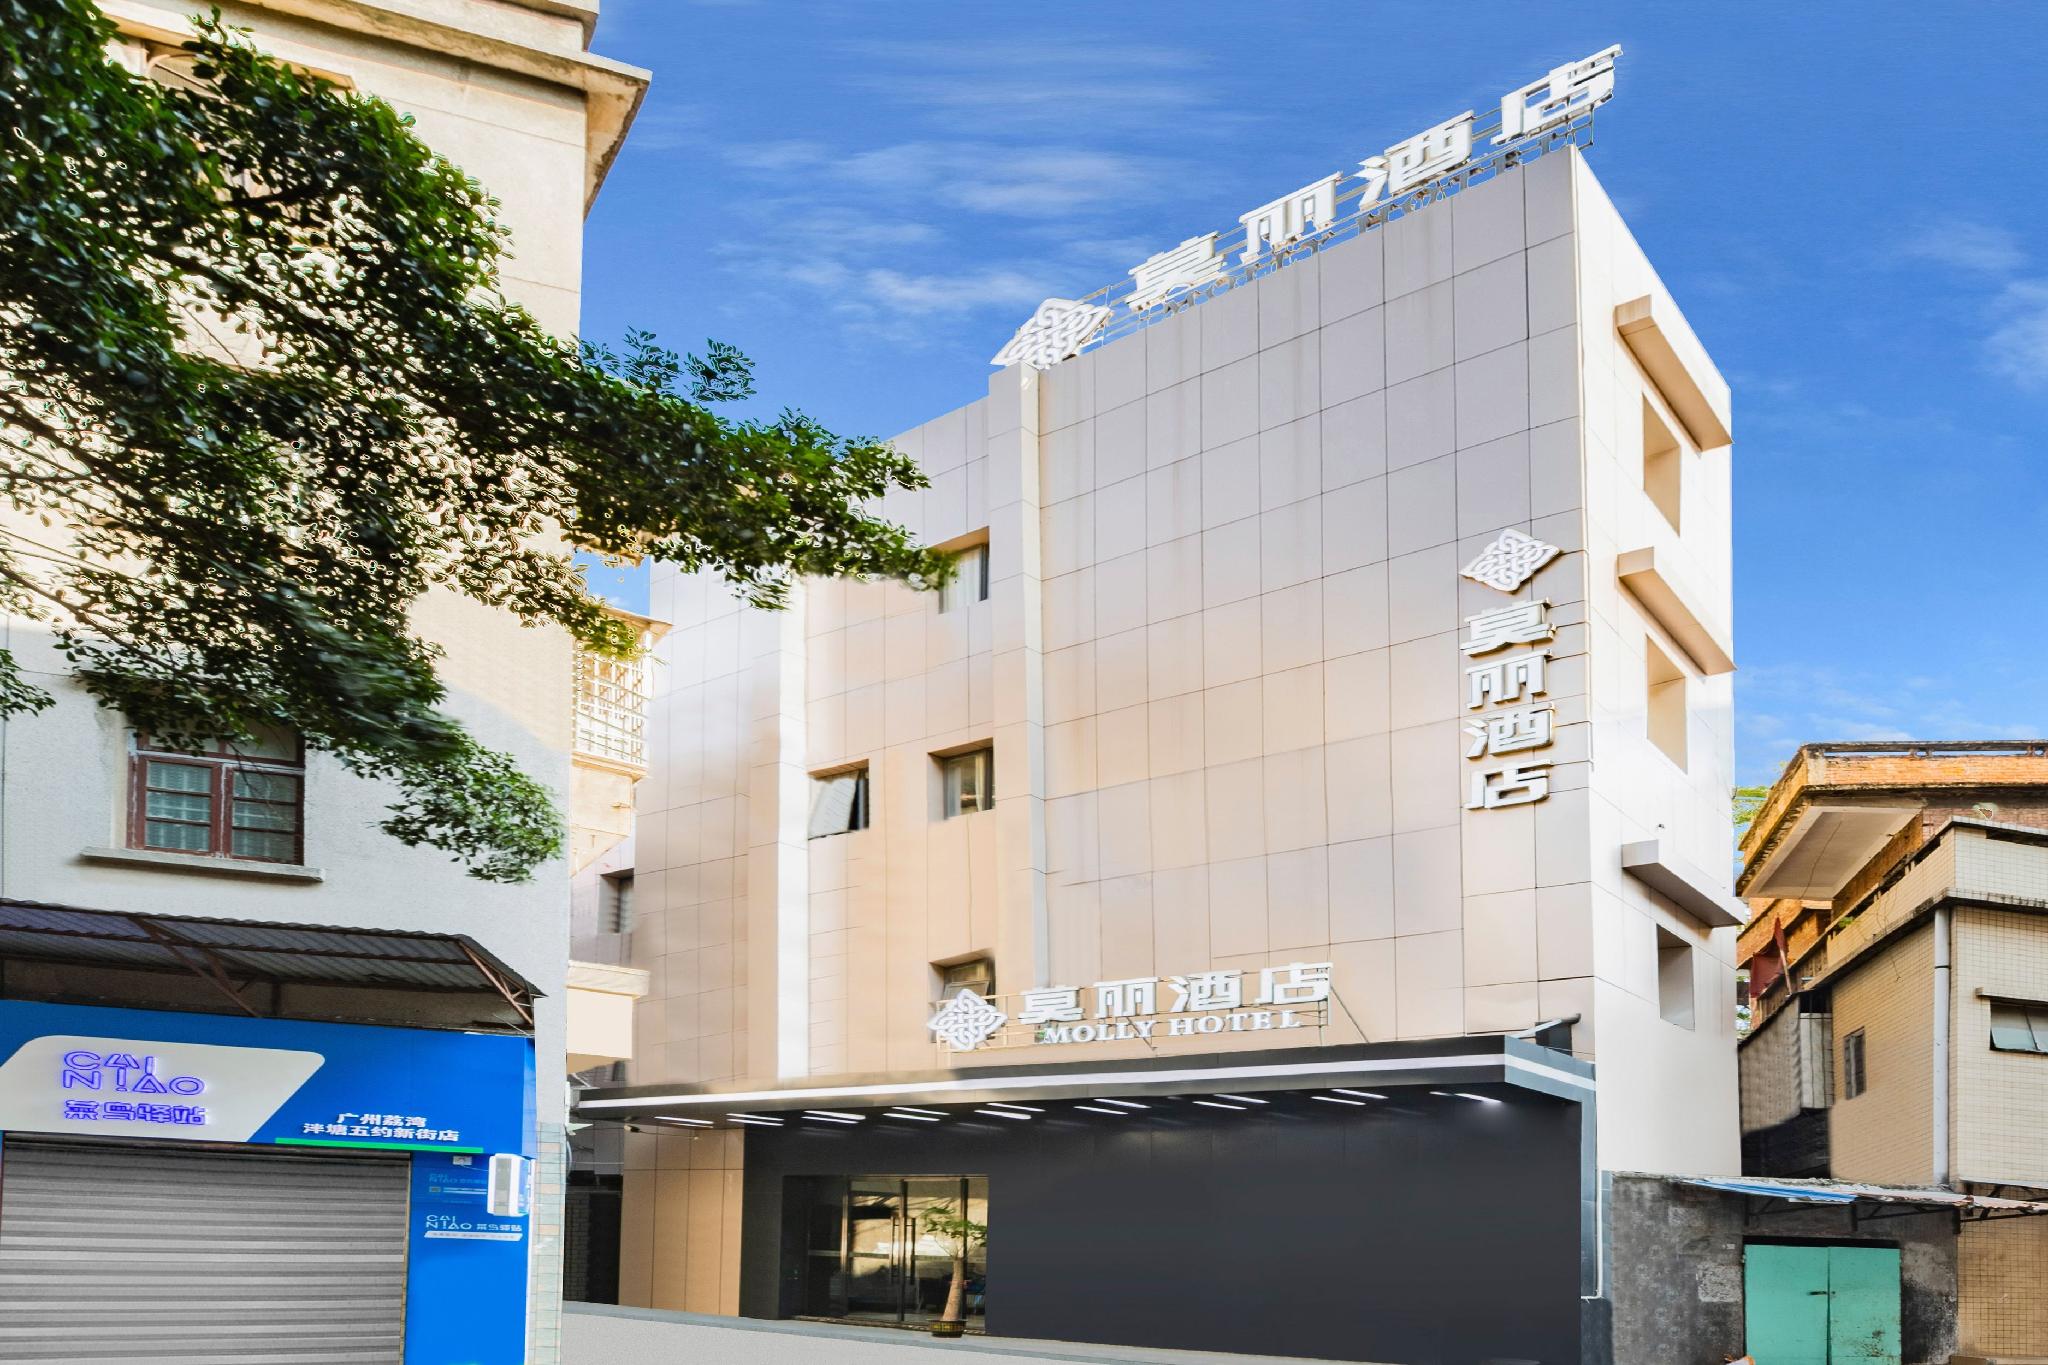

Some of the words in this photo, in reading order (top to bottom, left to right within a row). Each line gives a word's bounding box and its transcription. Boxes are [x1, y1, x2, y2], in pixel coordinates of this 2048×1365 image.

[1125, 43, 1623, 311] 莫丽酒店
[1460, 597, 1556, 810] 莫丽酒店
[1018, 962, 1334, 1024] 莫丽酒店
[1043, 1020, 1156, 1045] MOLLY
[1168, 1010, 1301, 1036] HOTEL
[63, 1100, 207, 1126] 菜鸟驿站
[336, 1112, 428, 1128] 广州荔湾
[302, 1123, 460, 1142] 泮塘五约新街店
